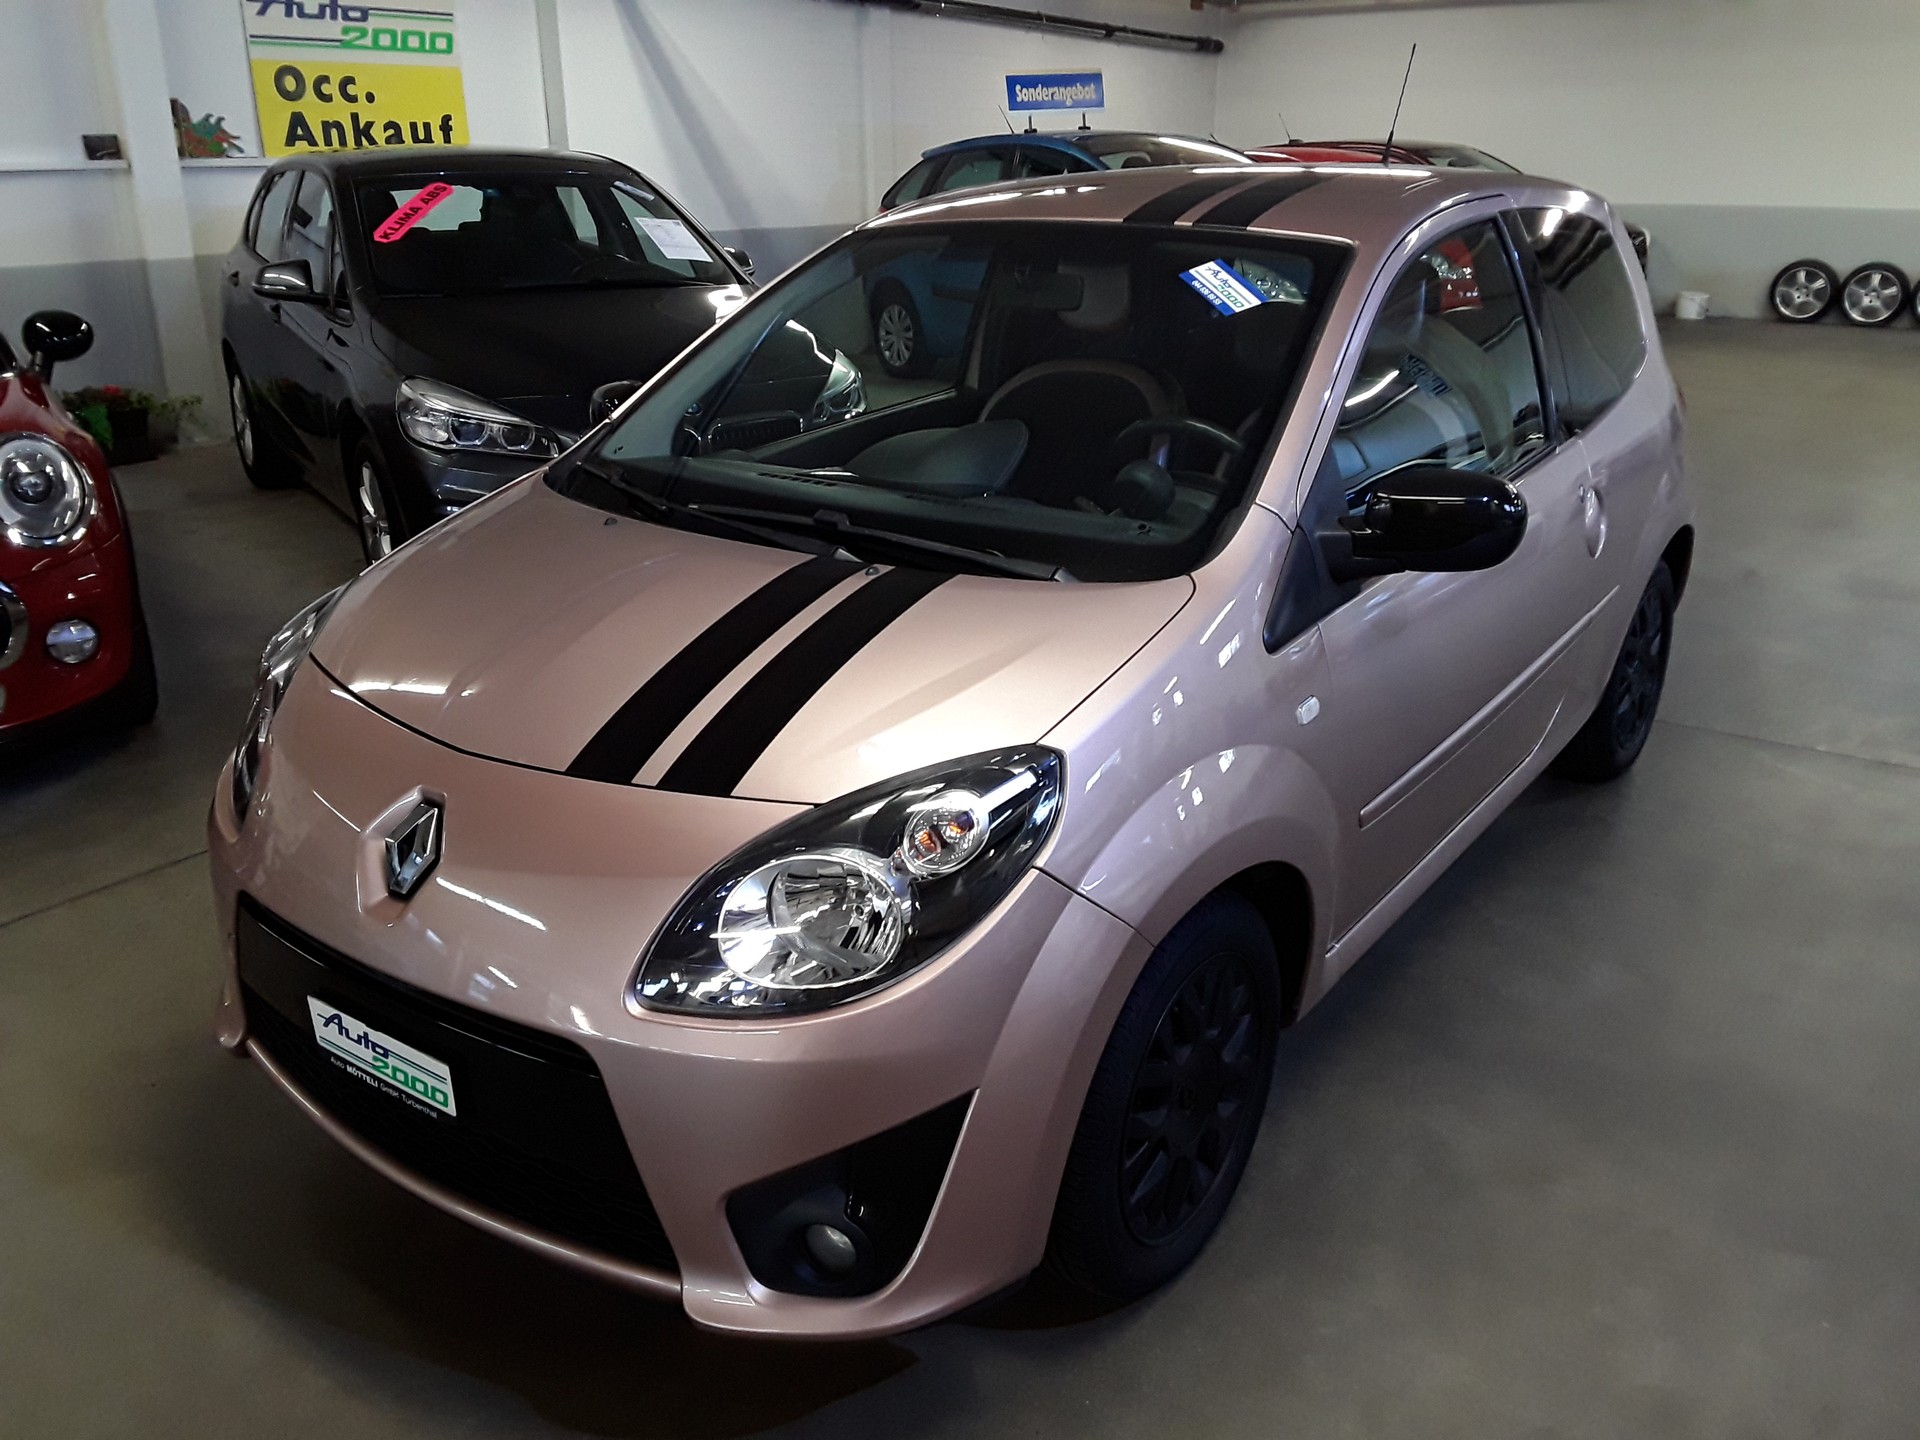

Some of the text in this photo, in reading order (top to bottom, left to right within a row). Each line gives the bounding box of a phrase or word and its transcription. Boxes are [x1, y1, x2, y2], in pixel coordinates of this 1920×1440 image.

[340, 26, 453, 54] 2000
[274, 65, 376, 103] Occ.
[1015, 82, 1096, 106] Sonderangebot
[284, 111, 453, 148] Ankauf
[379, 184, 448, 240] KLIMA ABS
[1205, 266, 1232, 288] Auto
[1217, 284, 1244, 308] 2000
[322, 1013, 390, 1060] Auto
[330, 1056, 345, 1069] Auto
[346, 1064, 379, 1088] MÖTTELI
[371, 1055, 449, 1108] 2000
